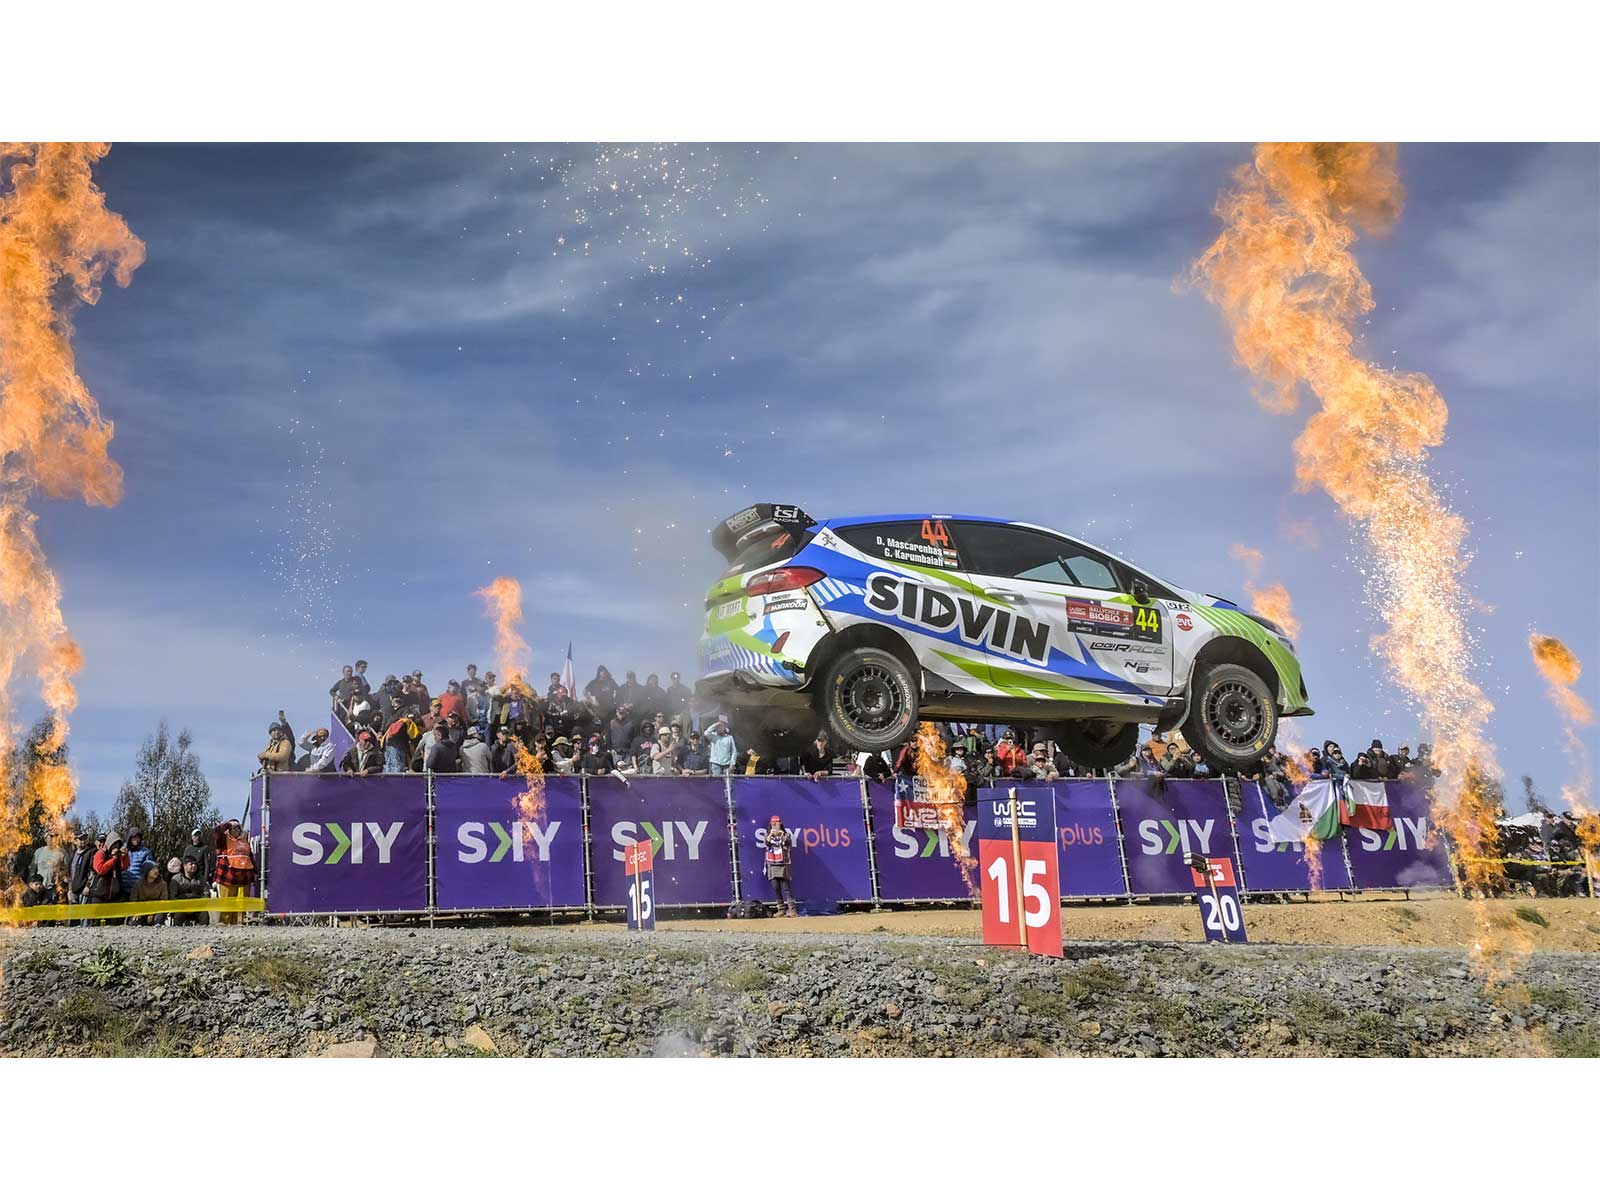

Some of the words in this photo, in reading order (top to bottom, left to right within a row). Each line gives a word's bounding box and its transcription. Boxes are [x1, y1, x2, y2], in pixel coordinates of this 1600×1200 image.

[774, 505, 799, 519] tsi
[876, 536, 886, 546] D.
[887, 538, 943, 557] Mascarenhas
[921, 519, 949, 547] 44
[884, 547, 893, 558] G.
[867, 574, 1052, 664] SIDVIN
[1135, 607, 1159, 633] 44
[628, 879, 652, 921] 15
[987, 856, 1051, 929] 15
[1201, 894, 1240, 931] 20
